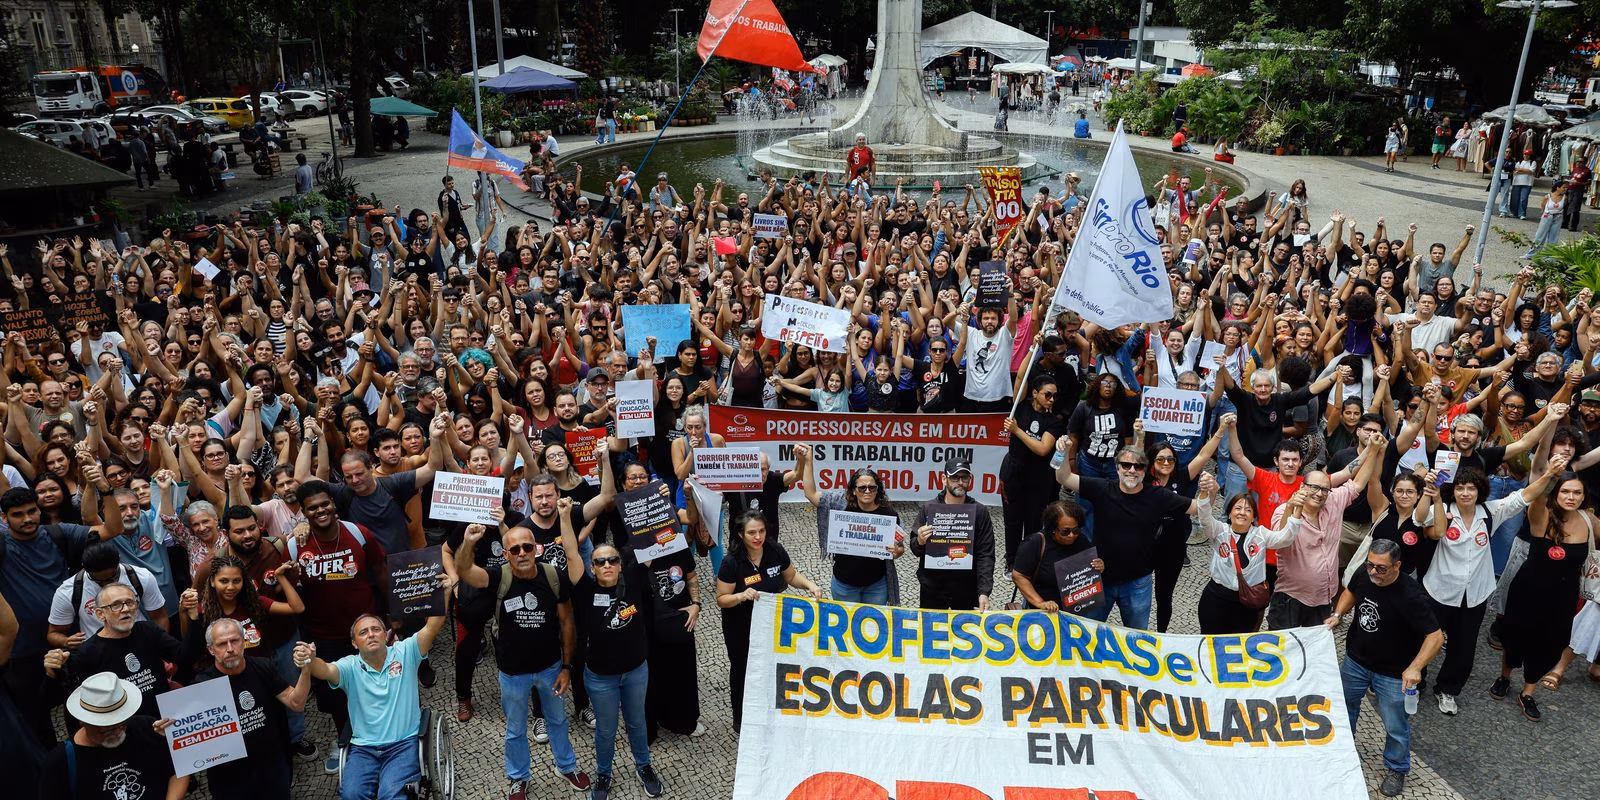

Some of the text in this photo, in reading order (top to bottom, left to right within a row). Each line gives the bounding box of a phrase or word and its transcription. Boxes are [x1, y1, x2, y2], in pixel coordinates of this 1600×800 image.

[752, 19, 793, 36] TRABALH
[64, 302, 87, 310] HOJE
[772, 296, 830, 321] Professores
[6, 310, 44, 321] QUANTO
[4, 317, 48, 331] VALE UM
[780, 327, 829, 350] RESPEITO
[619, 398, 650, 407] ONDE TEM
[1143, 396, 1205, 413] ESCOLA NÃO
[635, 411, 650, 419] LUTA!
[1142, 405, 1151, 420] É
[1151, 409, 1195, 425] QUARTEL
[726, 425, 756, 433] SinproRio
[766, 419, 914, 438] PROFESSORES/AS
[918, 422, 943, 439] EM
[948, 423, 989, 440] LUTA
[1094, 413, 1116, 435] UP
[571, 445, 594, 453] ACABA
[575, 450, 592, 458] SALA
[832, 445, 926, 463] TRABALHO
[931, 446, 975, 465] COM
[696, 453, 759, 462] CORRIGIR PROVAS
[696, 461, 760, 470] TAMBÉM É TRABALHO!
[437, 482, 500, 496] RELATÓRIOS TAMBÉM
[452, 476, 488, 487] PREENCHER
[440, 491, 493, 508] É TRABALHO!
[624, 493, 661, 509] Planejar aula
[625, 499, 664, 515] Corrigir prova
[623, 502, 671, 523] Produzir material
[630, 512, 669, 528] Fazer reunião
[838, 528, 884, 542] É TRABALHO!
[847, 523, 877, 534] TAMBÉM
[391, 562, 440, 577] educação de
[1070, 567, 1092, 578] resposta
[395, 570, 437, 586] qualidade
[1072, 575, 1087, 585] para
[392, 582, 430, 594] condições
[399, 587, 435, 599] trabalho
[1067, 585, 1098, 604] É GREVE
[620, 604, 637, 618] GREVE
[774, 594, 1307, 688] PROFESSORAS e (ES)
[775, 662, 1335, 748] ESCOLAS PARTICULARES
[174, 704, 228, 728] ONDE TEM
[241, 721, 266, 735] DIGITAL
[177, 724, 233, 749] TEM LUTA!
[1026, 731, 1096, 766] EM
